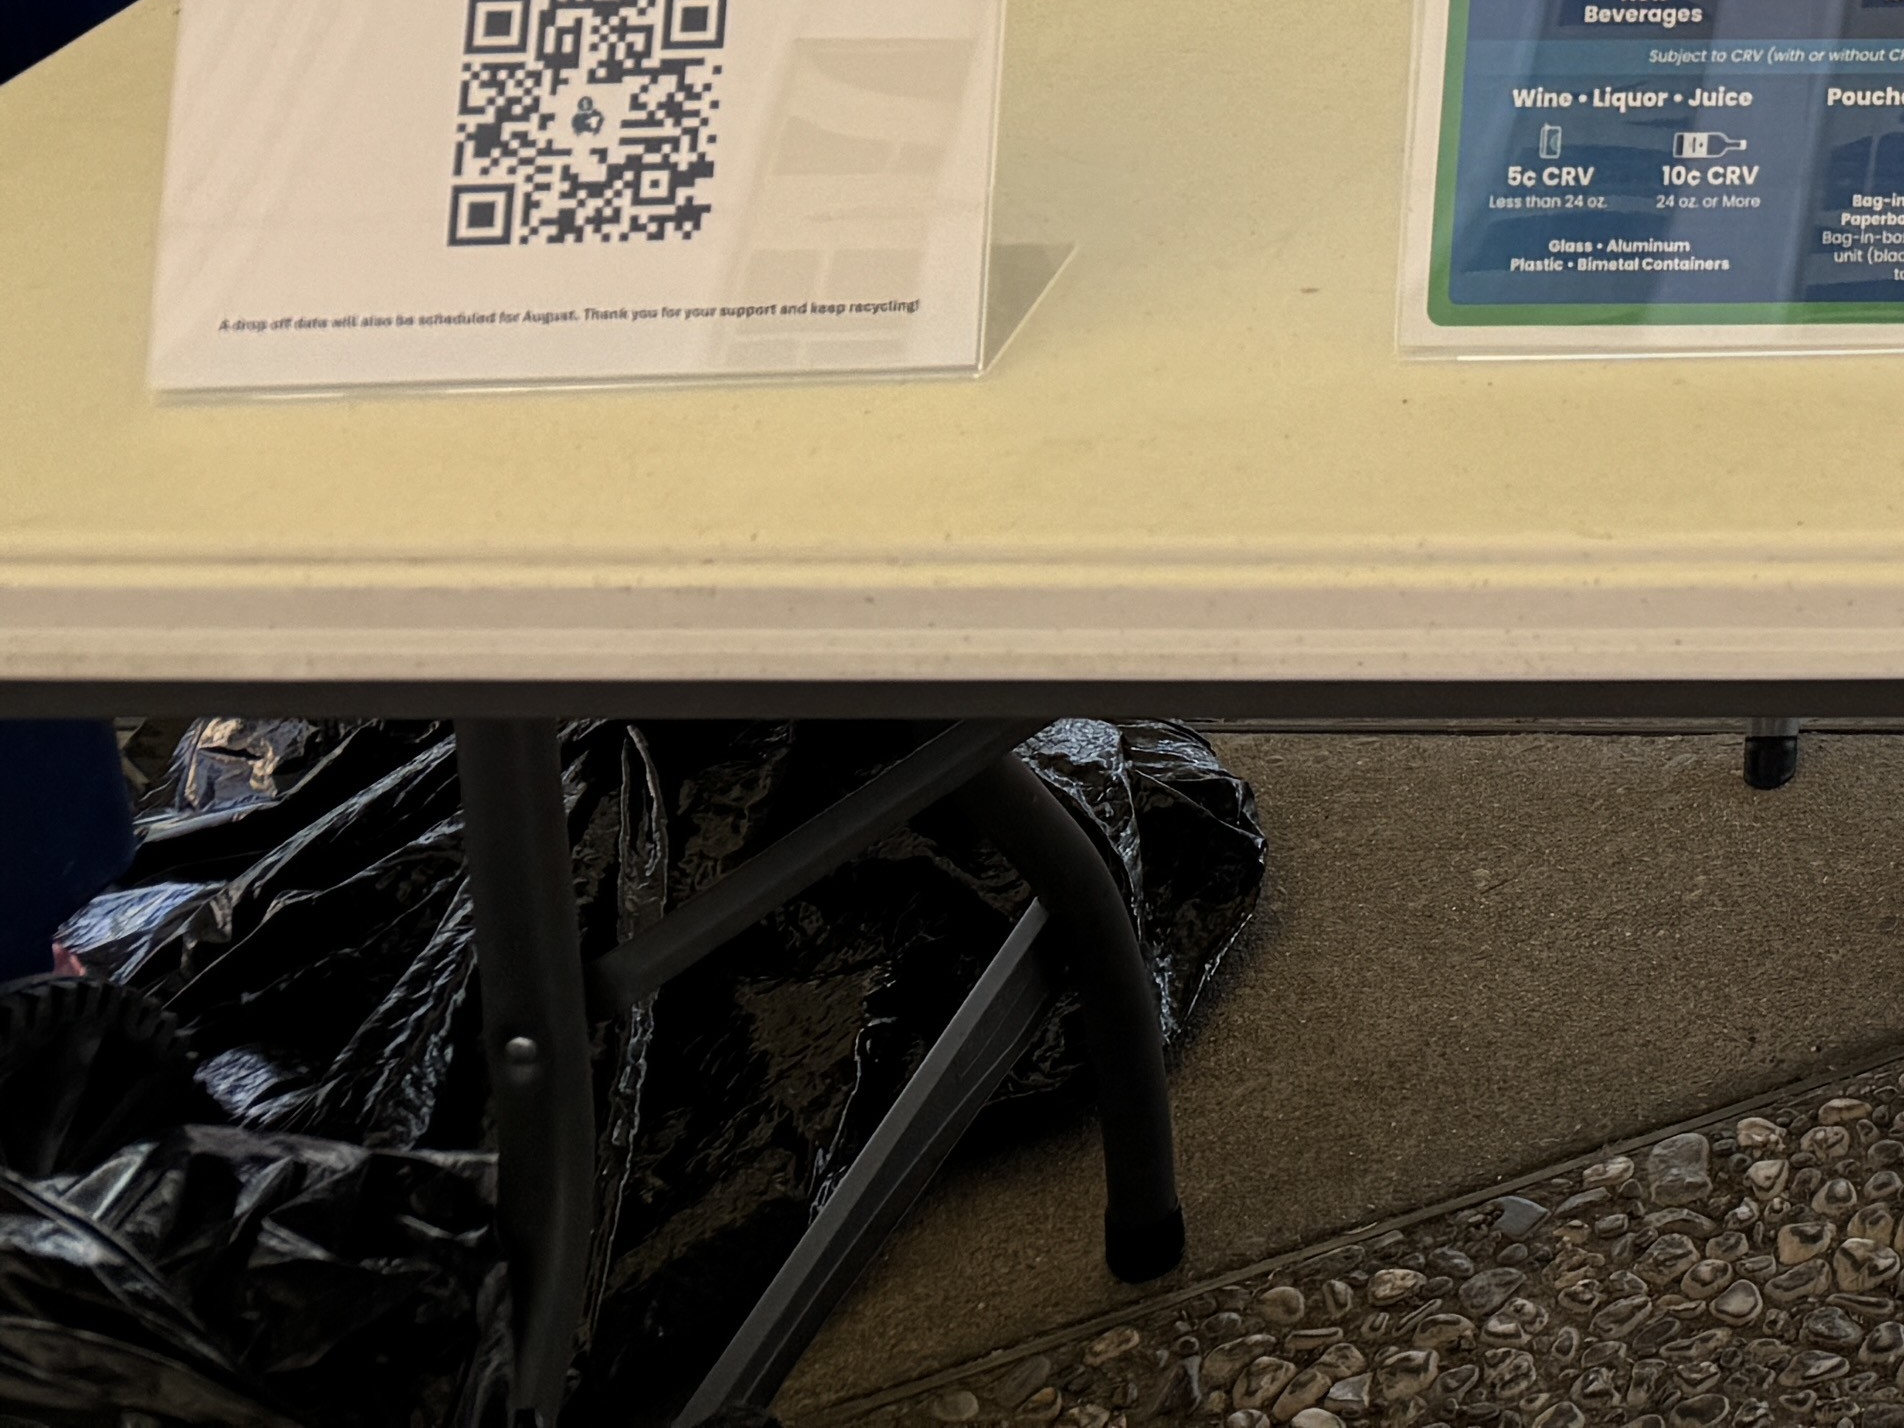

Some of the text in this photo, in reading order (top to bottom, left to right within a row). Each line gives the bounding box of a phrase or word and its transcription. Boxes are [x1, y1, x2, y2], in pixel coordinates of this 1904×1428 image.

[1584, 5, 1702, 28] Beverages
[1512, 86, 1752, 113] Wine Liquor Juice
[1542, 166, 1594, 186] CRV
[1707, 165, 1759, 185] CRV
[1548, 237, 1690, 252] Glass Aluminum
[1510, 256, 1729, 271] Plastic Bimetal Containers
